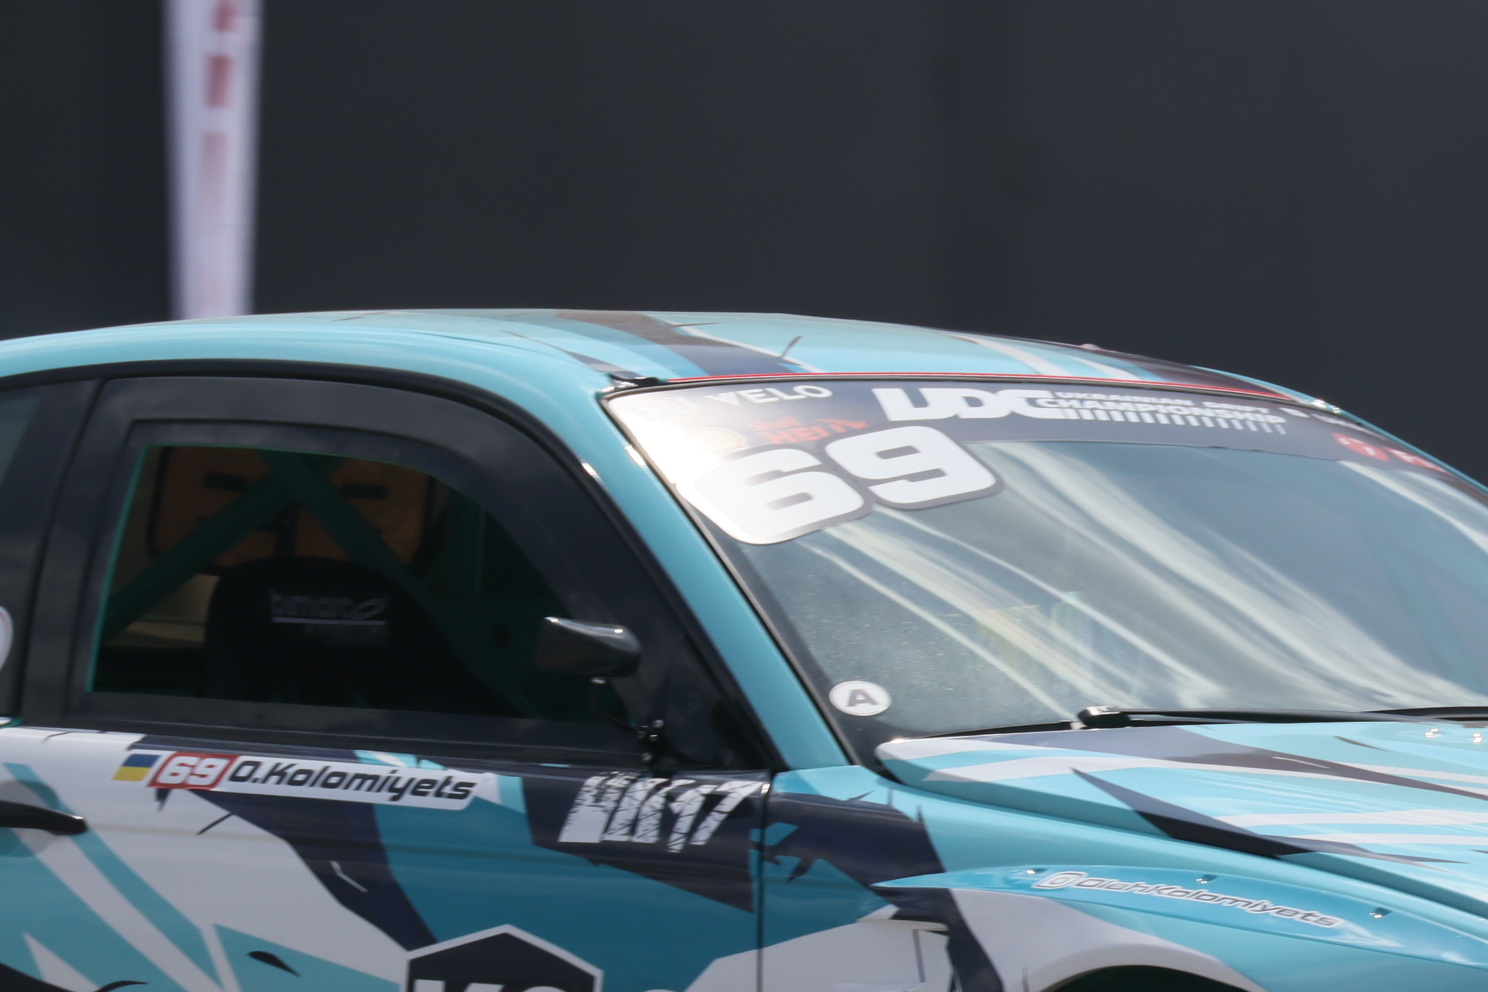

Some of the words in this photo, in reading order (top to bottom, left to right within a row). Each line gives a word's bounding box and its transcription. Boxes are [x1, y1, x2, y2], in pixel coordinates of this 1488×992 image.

[709, 385, 833, 407] VELO
[1036, 398, 1287, 424] CHAMPIONSHIP
[693, 426, 997, 541] 69
[846, 688, 880, 707] A
[156, 755, 221, 785] 69
[229, 760, 477, 801] O.Kolomiyets
